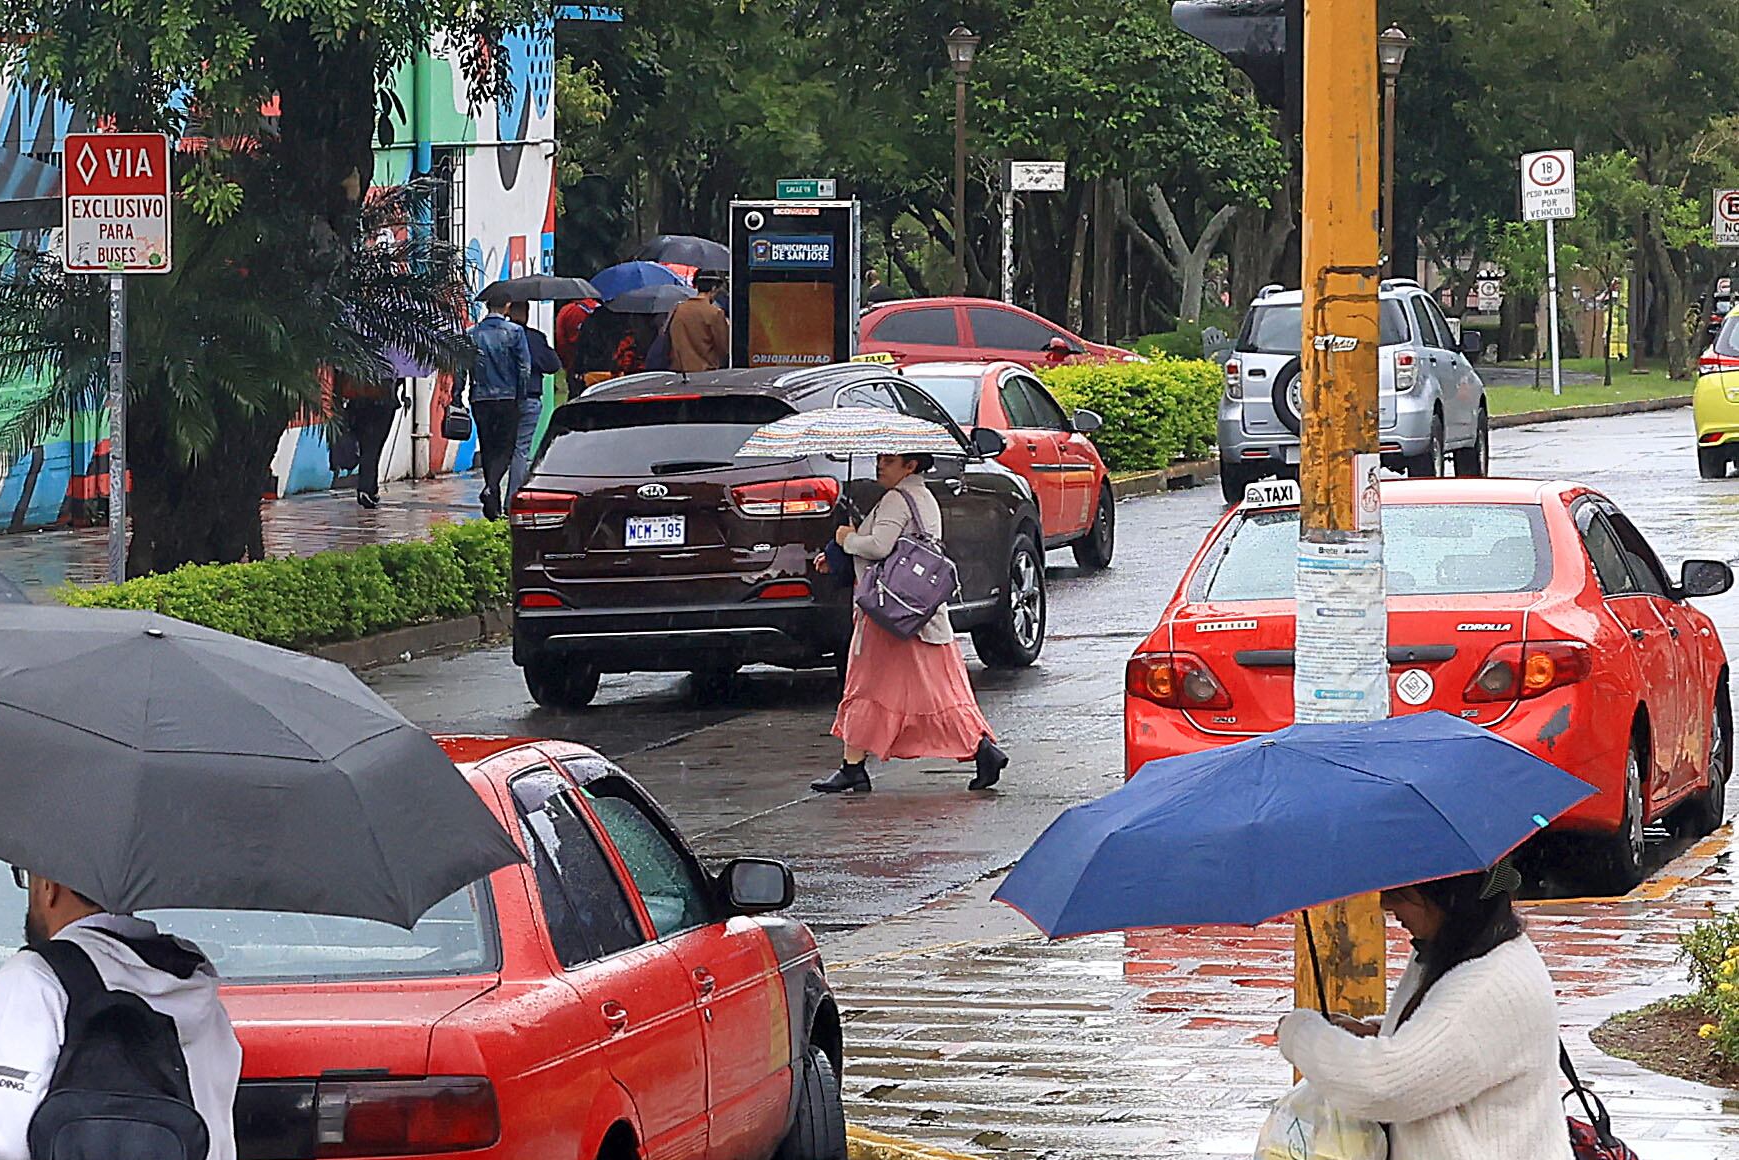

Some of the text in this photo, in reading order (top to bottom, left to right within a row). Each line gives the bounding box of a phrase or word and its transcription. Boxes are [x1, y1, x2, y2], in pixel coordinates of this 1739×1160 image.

[105, 148, 153, 178] VIA
[1542, 162, 1553, 174] 18
[72, 199, 163, 218] EXCLUSIVO
[1541, 199, 1558, 207] POR
[1531, 207, 1570, 217] VEHICULO
[99, 224, 134, 239] PARA
[772, 244, 829, 252] MUNICIPALIDAD
[97, 247, 137, 263] BUSES
[772, 251, 785, 260] DE
[786, 251, 806, 260] SAN
[752, 355, 831, 363] ORIGINALIDAD
[1264, 486, 1293, 502] TAXI
[629, 523, 682, 539] NCM-195
[1456, 623, 1512, 631] COROLLA
